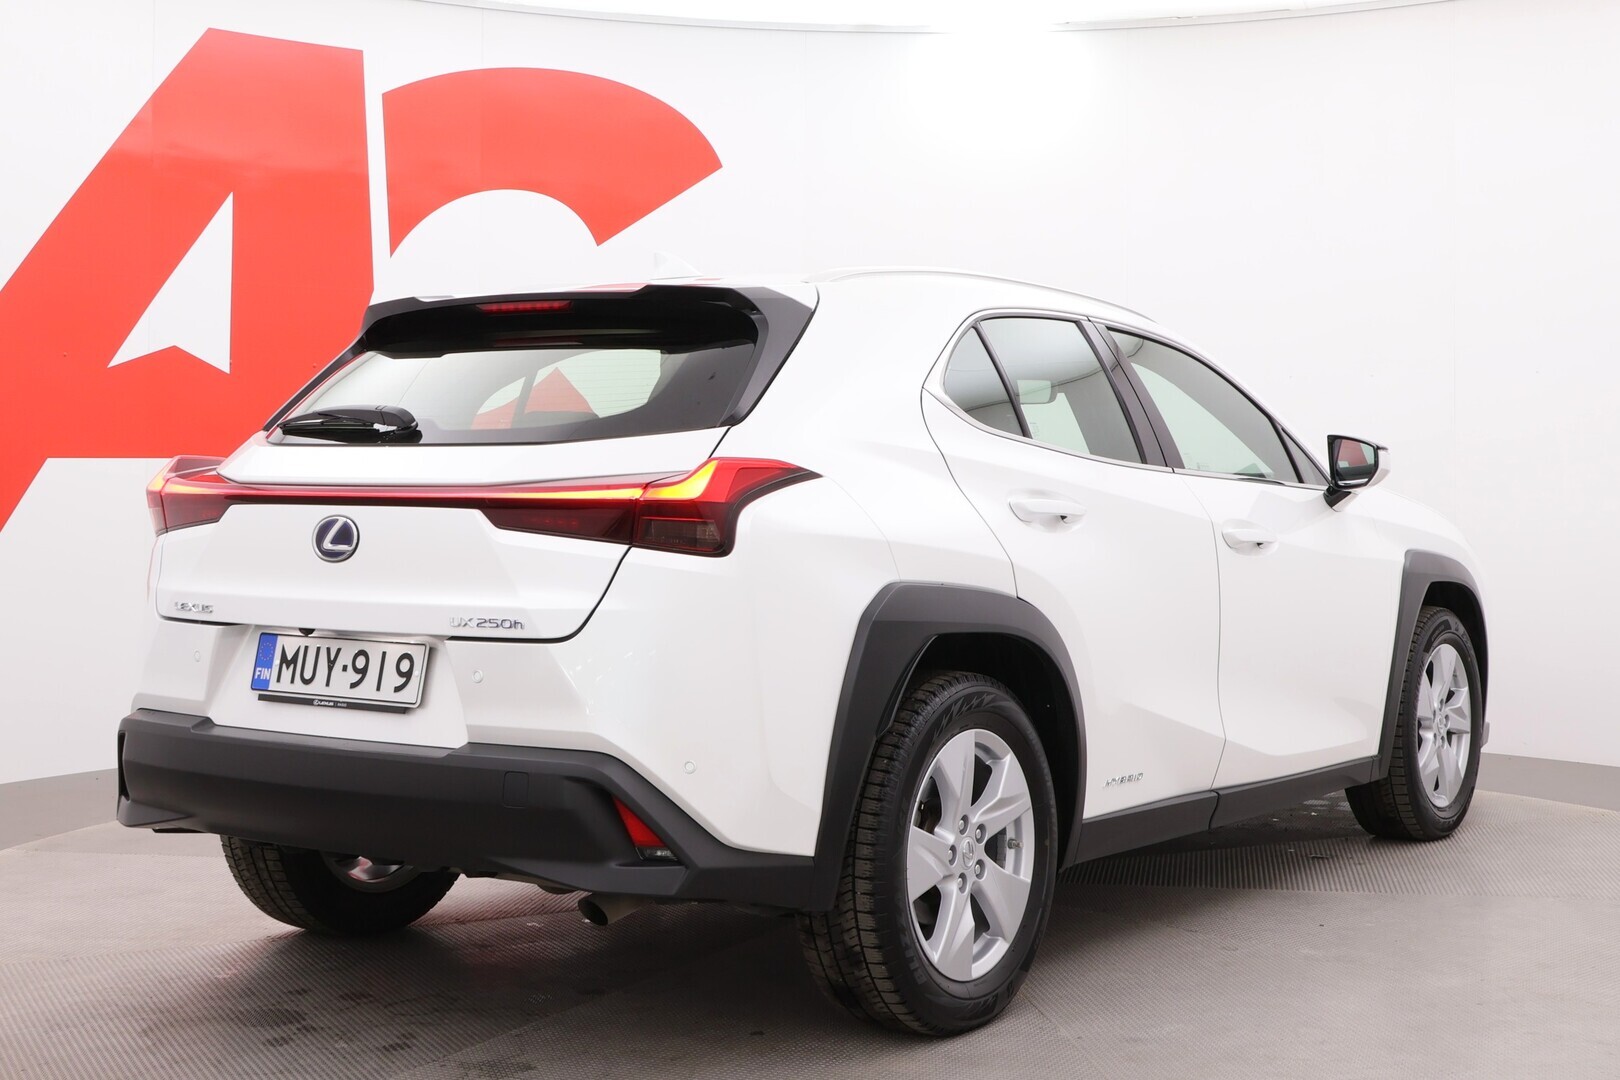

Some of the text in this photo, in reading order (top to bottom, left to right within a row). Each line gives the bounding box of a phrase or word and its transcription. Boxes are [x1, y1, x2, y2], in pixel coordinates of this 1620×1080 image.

[175, 601, 213, 613] LEXUS
[254, 667, 271, 680] FIN
[276, 643, 415, 693] MUY-919
